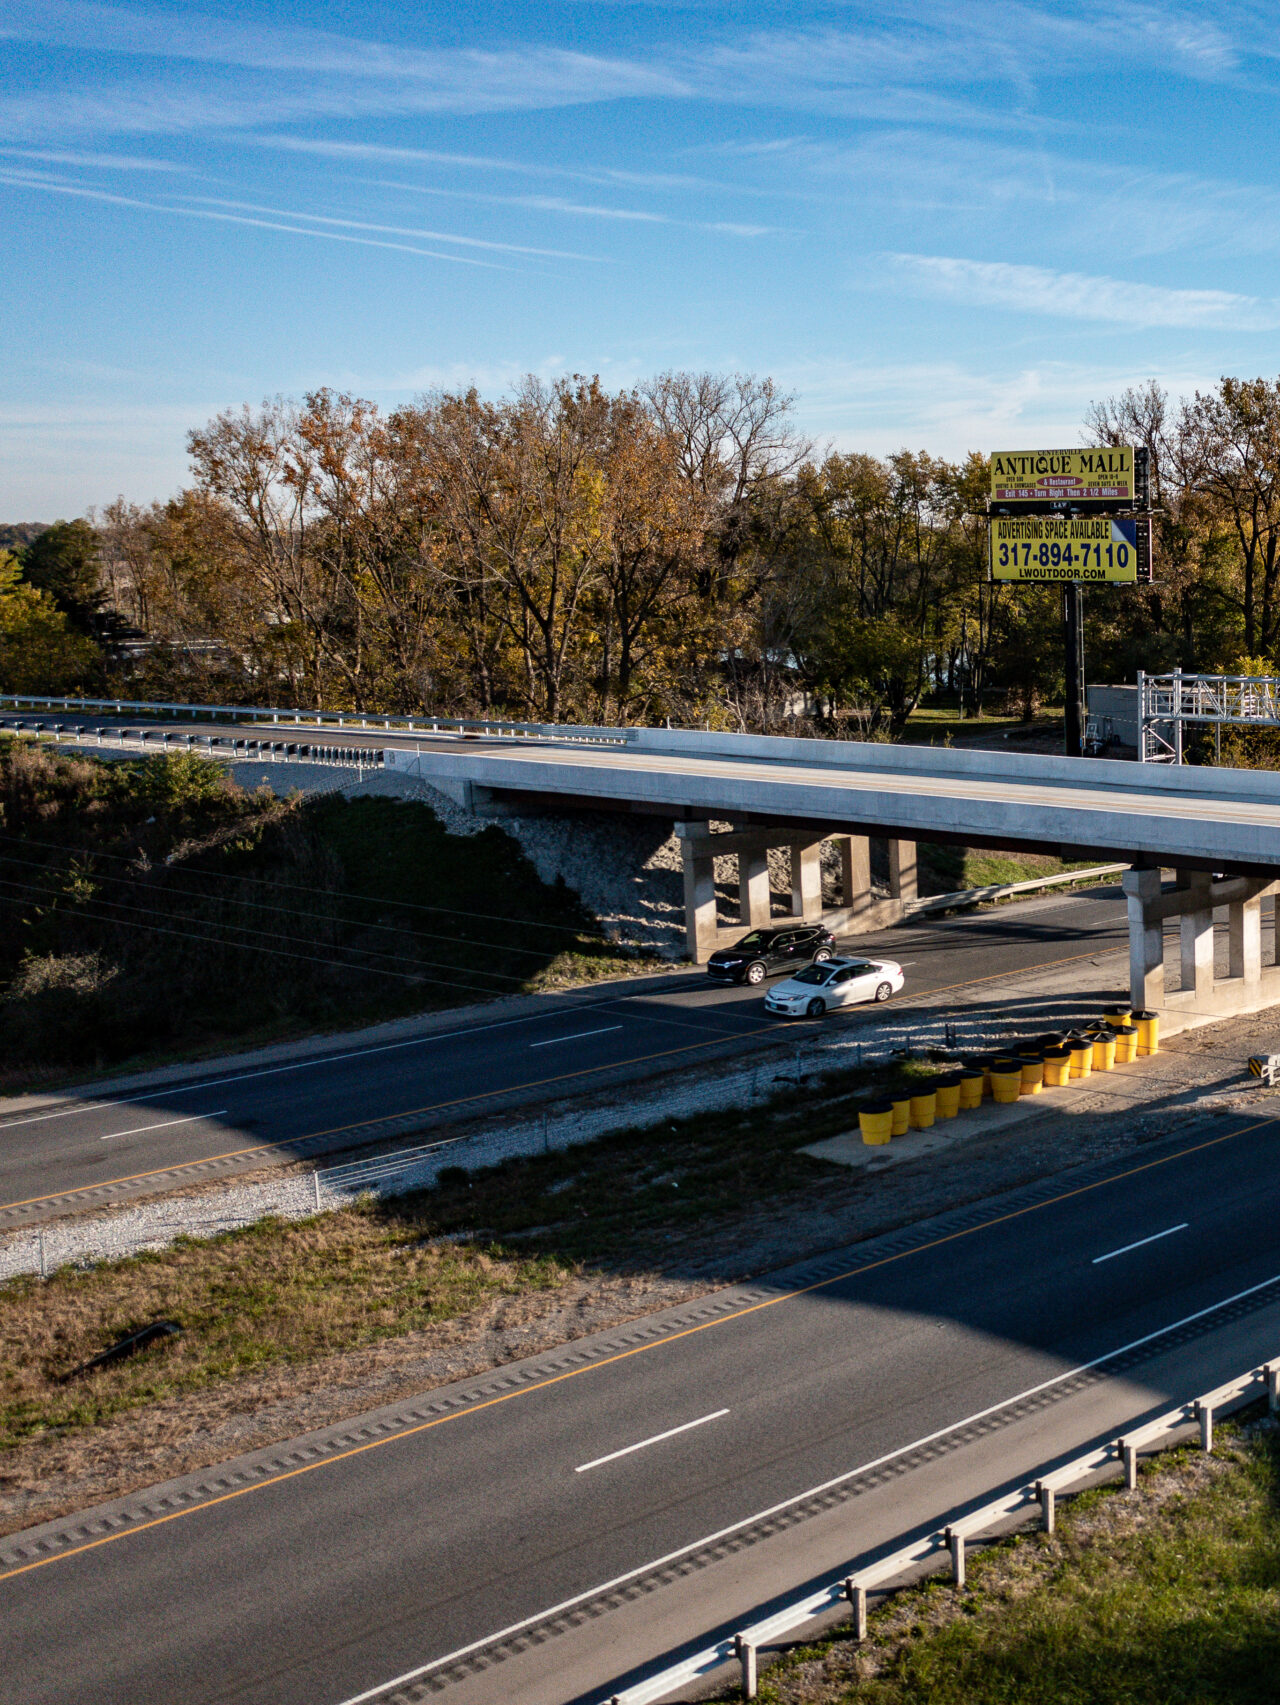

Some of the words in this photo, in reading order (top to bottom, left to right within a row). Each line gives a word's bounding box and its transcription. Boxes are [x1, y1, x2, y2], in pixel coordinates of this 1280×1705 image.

[994, 456, 1071, 475] ANTIQUE
[1080, 454, 1130, 473] MALL
[1049, 478, 1076, 486] Restaurant
[1005, 490, 1016, 498] Exit
[1018, 490, 1029, 498] 145
[1034, 489, 1047, 497] Turn
[1049, 488, 1064, 499] Right
[1067, 488, 1081, 497] Then
[1082, 488, 1088, 497] 2
[1090, 488, 1099, 497] 1/2
[1102, 487, 1119, 496] Miles
[998, 522, 1043, 540] ADVERTISING
[1045, 522, 1068, 540] SPACE
[1070, 522, 1109, 539] AVAILABLE
[999, 543, 1129, 568] 317-894-7110
[1019, 569, 1106, 579] LWOUTDOOR.COM
